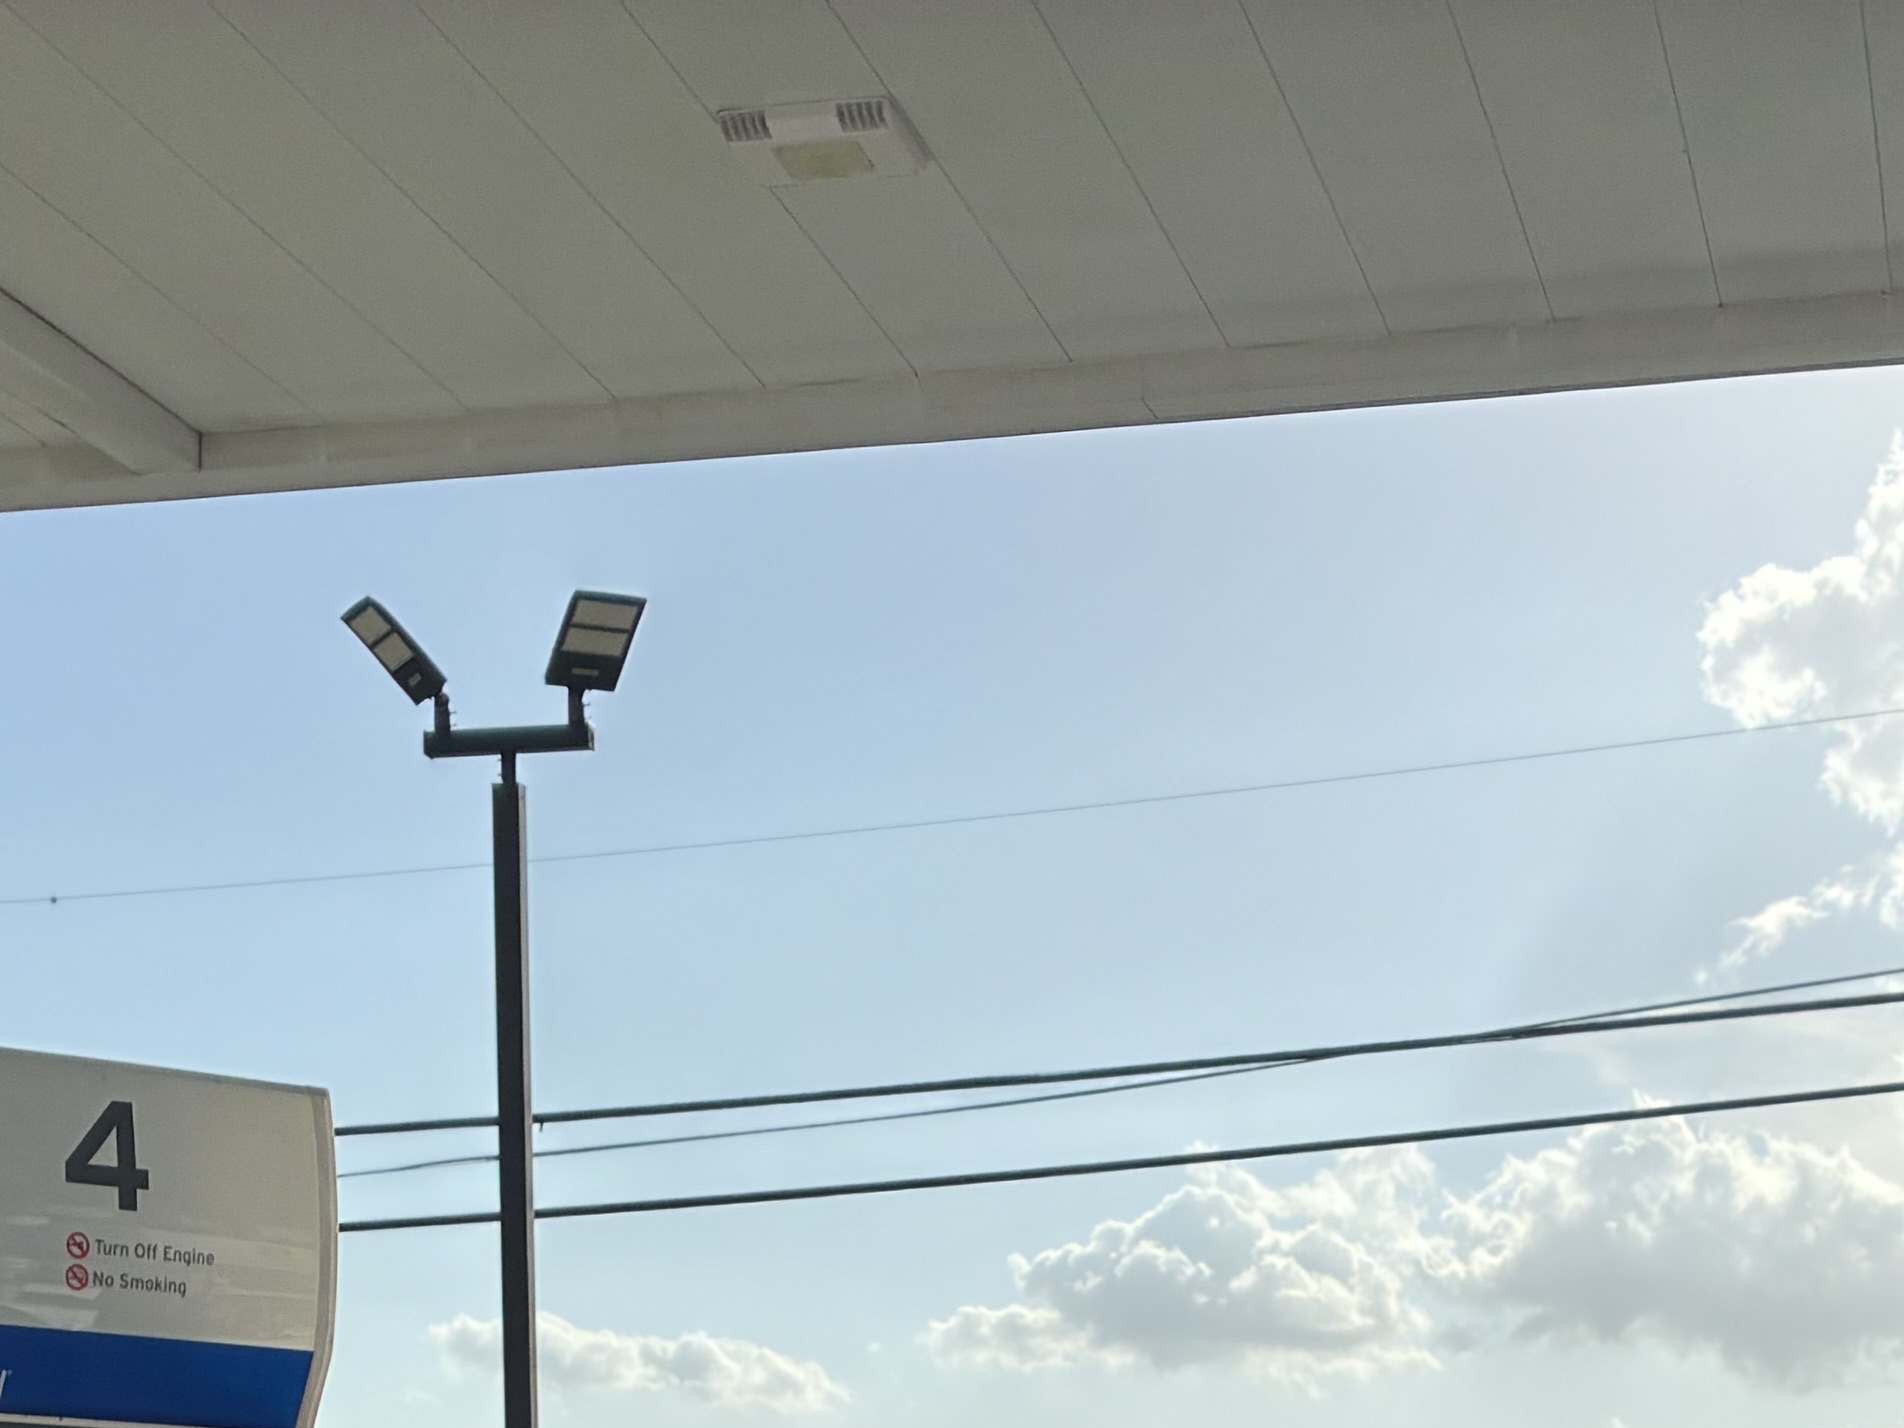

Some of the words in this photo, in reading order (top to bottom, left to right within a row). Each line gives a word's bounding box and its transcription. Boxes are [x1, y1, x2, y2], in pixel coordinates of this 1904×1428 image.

[65, 1101, 149, 1211] 4
[94, 1238, 129, 1260] Turn
[134, 1241, 158, 1262] Off
[163, 1244, 216, 1267] Engine
[92, 1271, 114, 1289] No
[118, 1273, 187, 1298] Smoking
